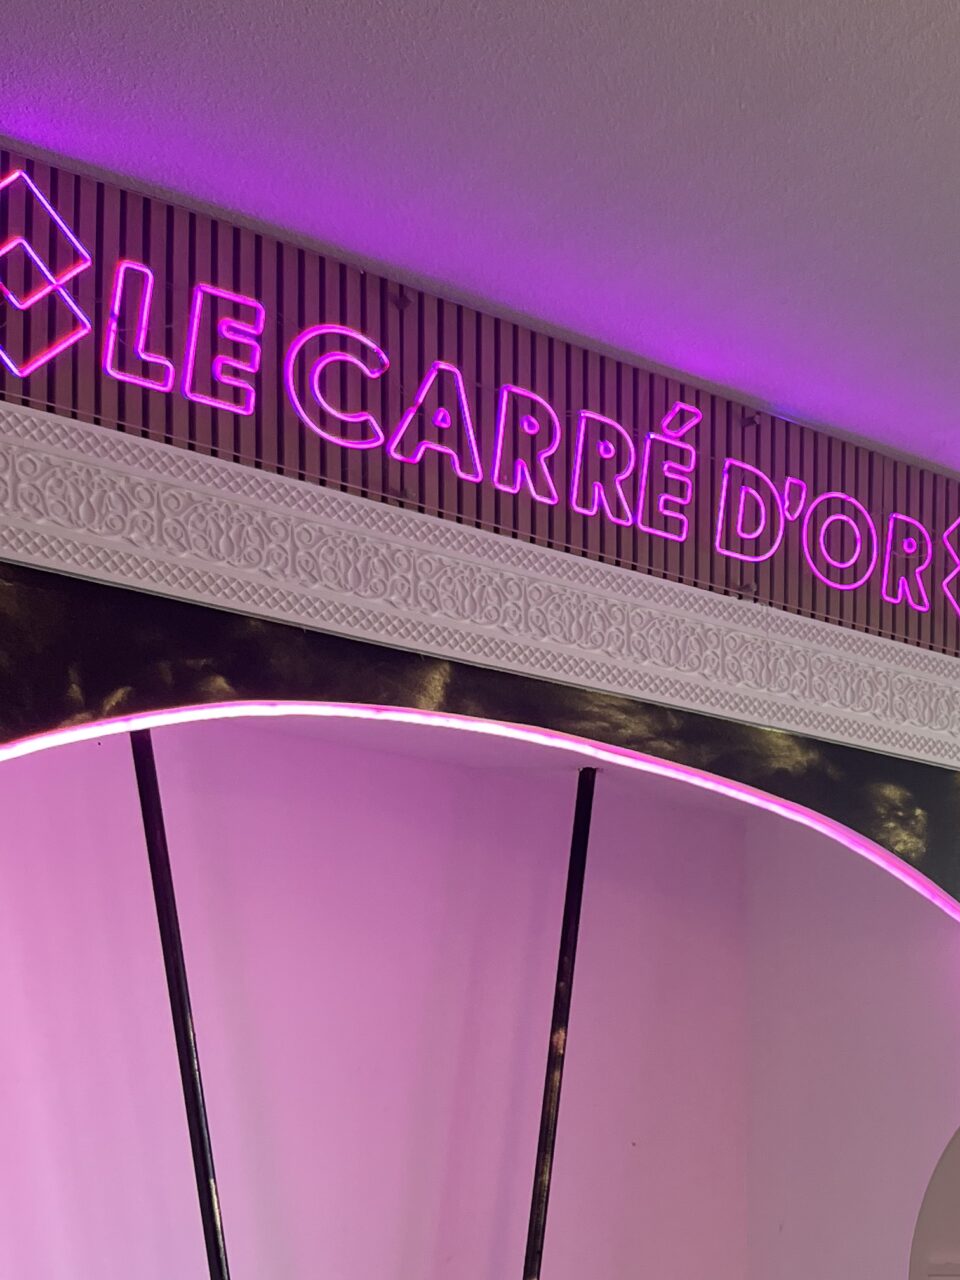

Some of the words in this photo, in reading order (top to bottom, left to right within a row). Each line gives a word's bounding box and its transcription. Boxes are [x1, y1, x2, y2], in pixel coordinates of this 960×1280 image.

[102, 258, 266, 416] LE
[283, 324, 703, 542] CARRÉ
[714, 456, 933, 612] D'OR
